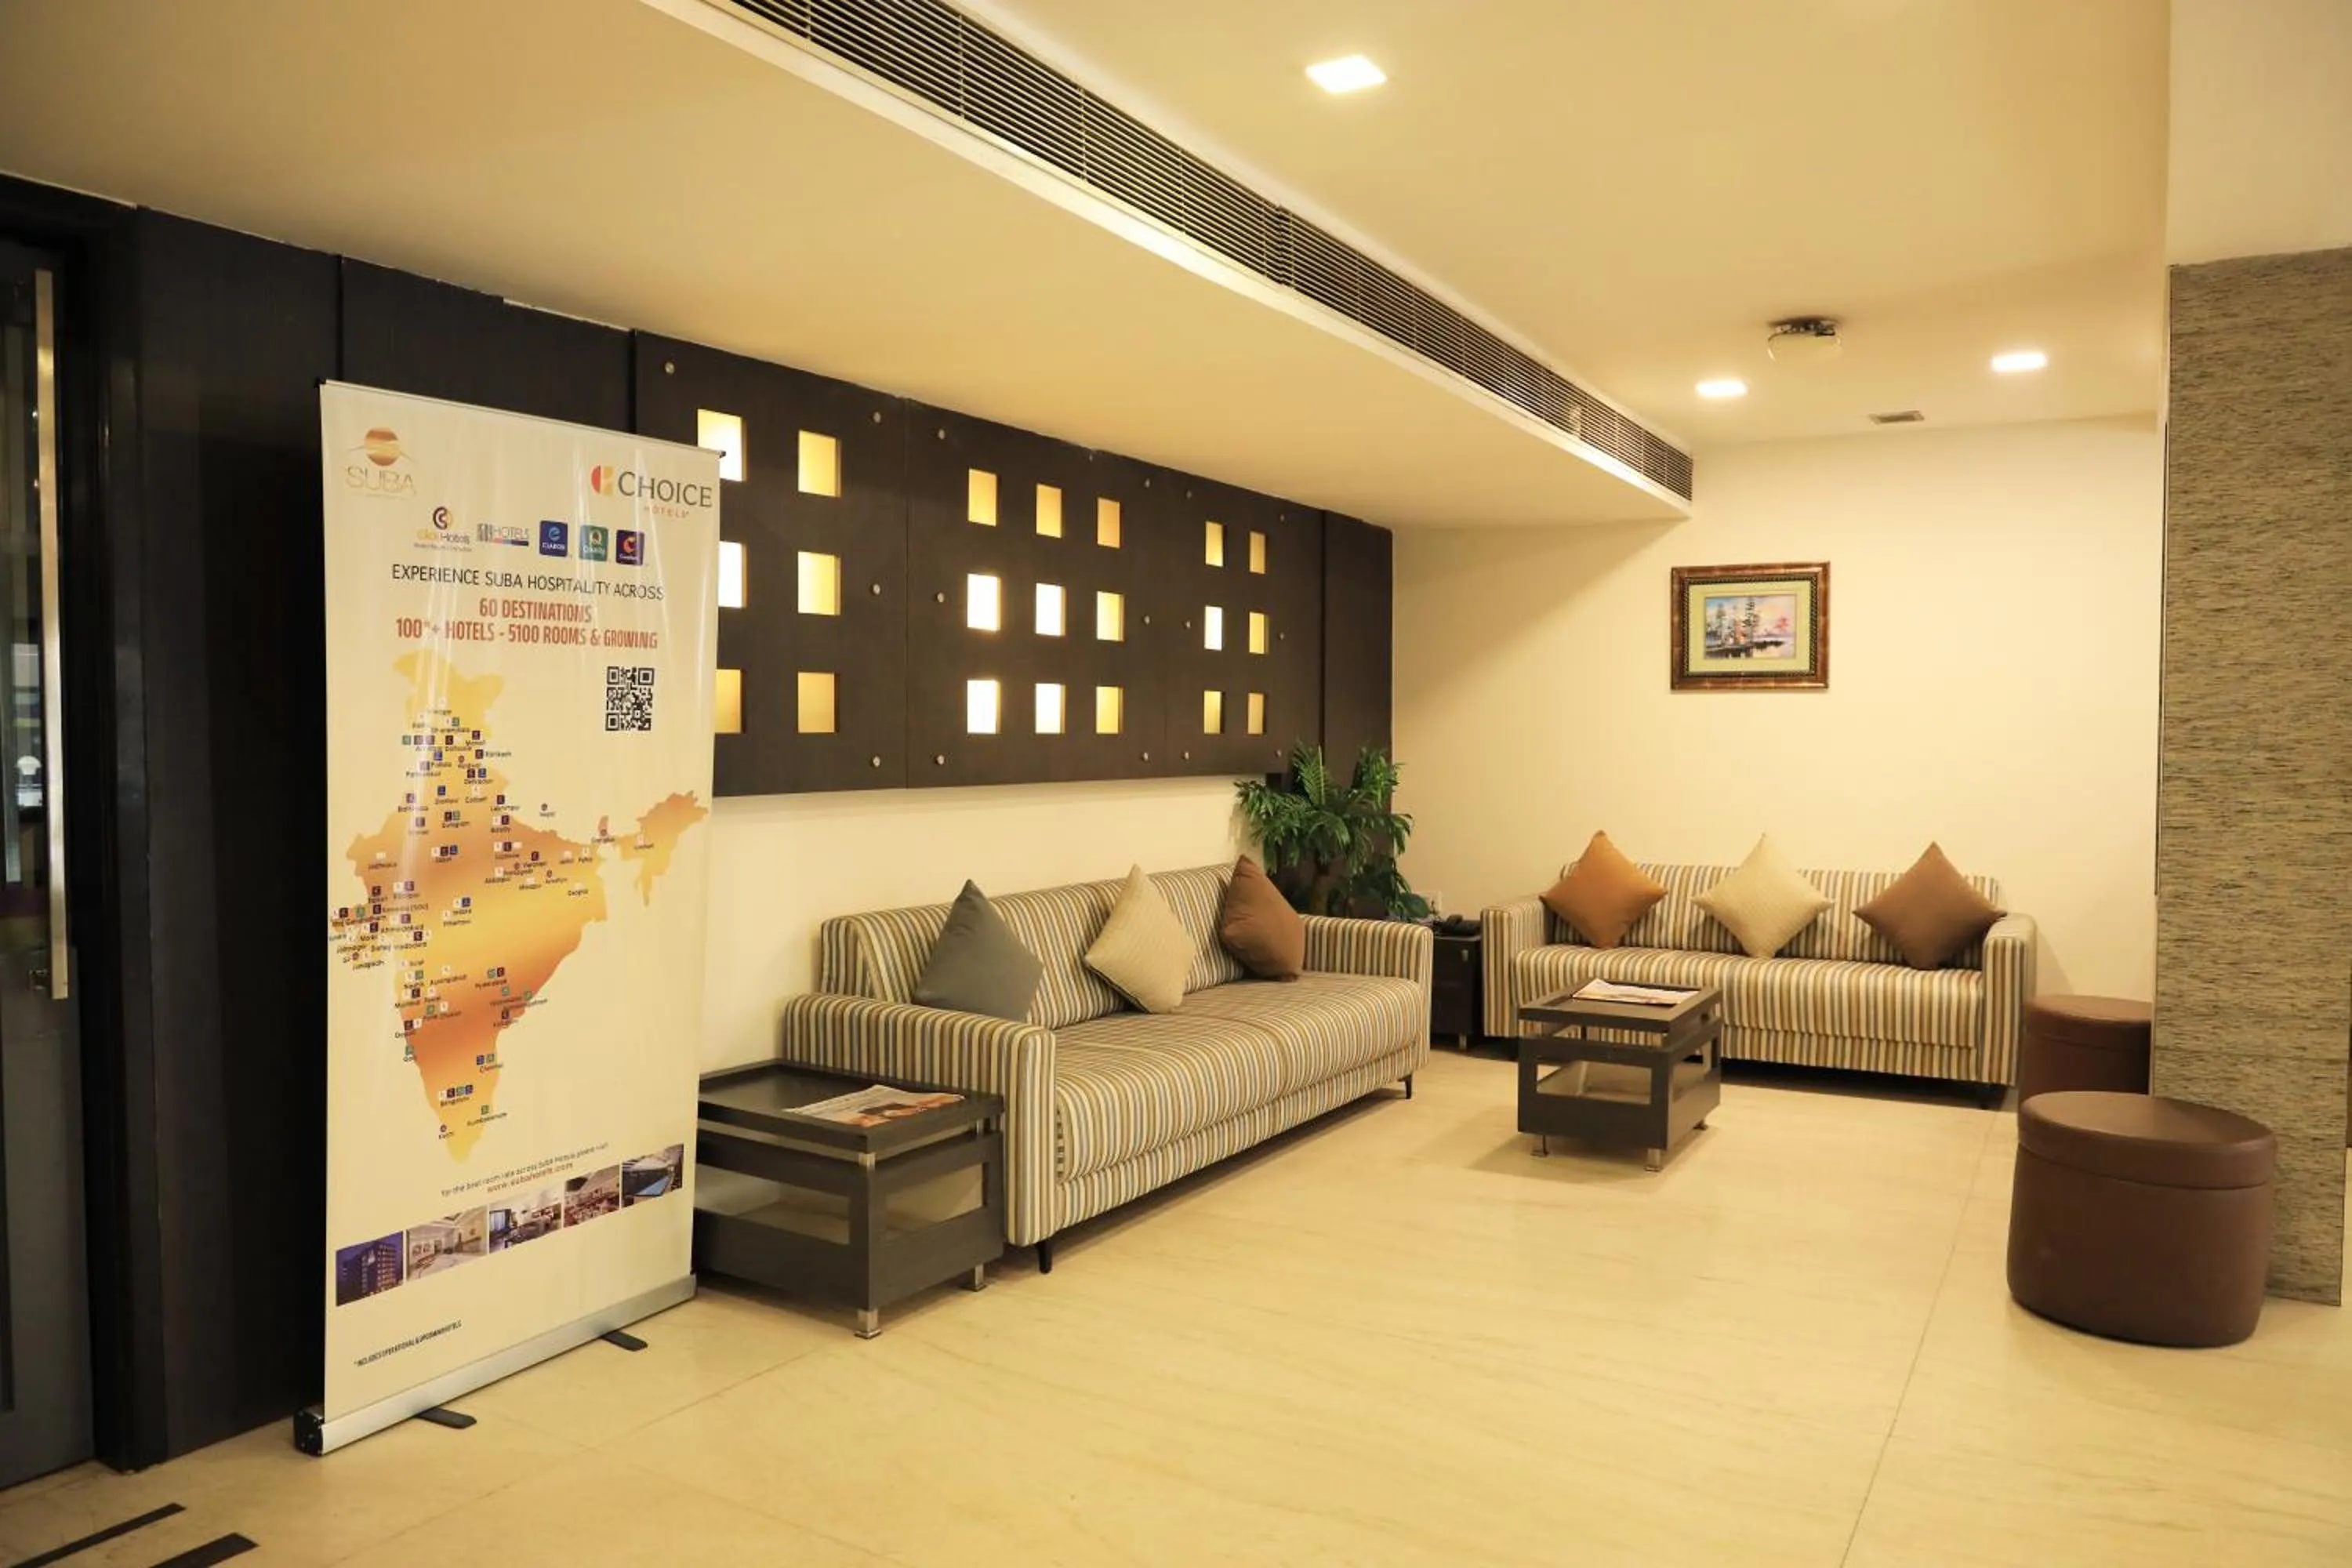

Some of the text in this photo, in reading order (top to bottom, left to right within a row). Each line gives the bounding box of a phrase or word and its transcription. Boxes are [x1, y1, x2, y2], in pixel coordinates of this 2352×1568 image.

[346, 466, 417, 496] SUBA
[618, 471, 712, 507] CHOICE
[392, 564, 664, 601] EXPERIENCE SUBA HOSPITALITY ACROSS
[479, 597, 592, 623] 60 DESTINATIONS
[445, 619, 495, 641] HOTELS
[508, 623, 540, 643] 5100
[543, 625, 586, 645] ROOMS
[590, 628, 601, 647] &
[604, 630, 658, 649] GROWING
